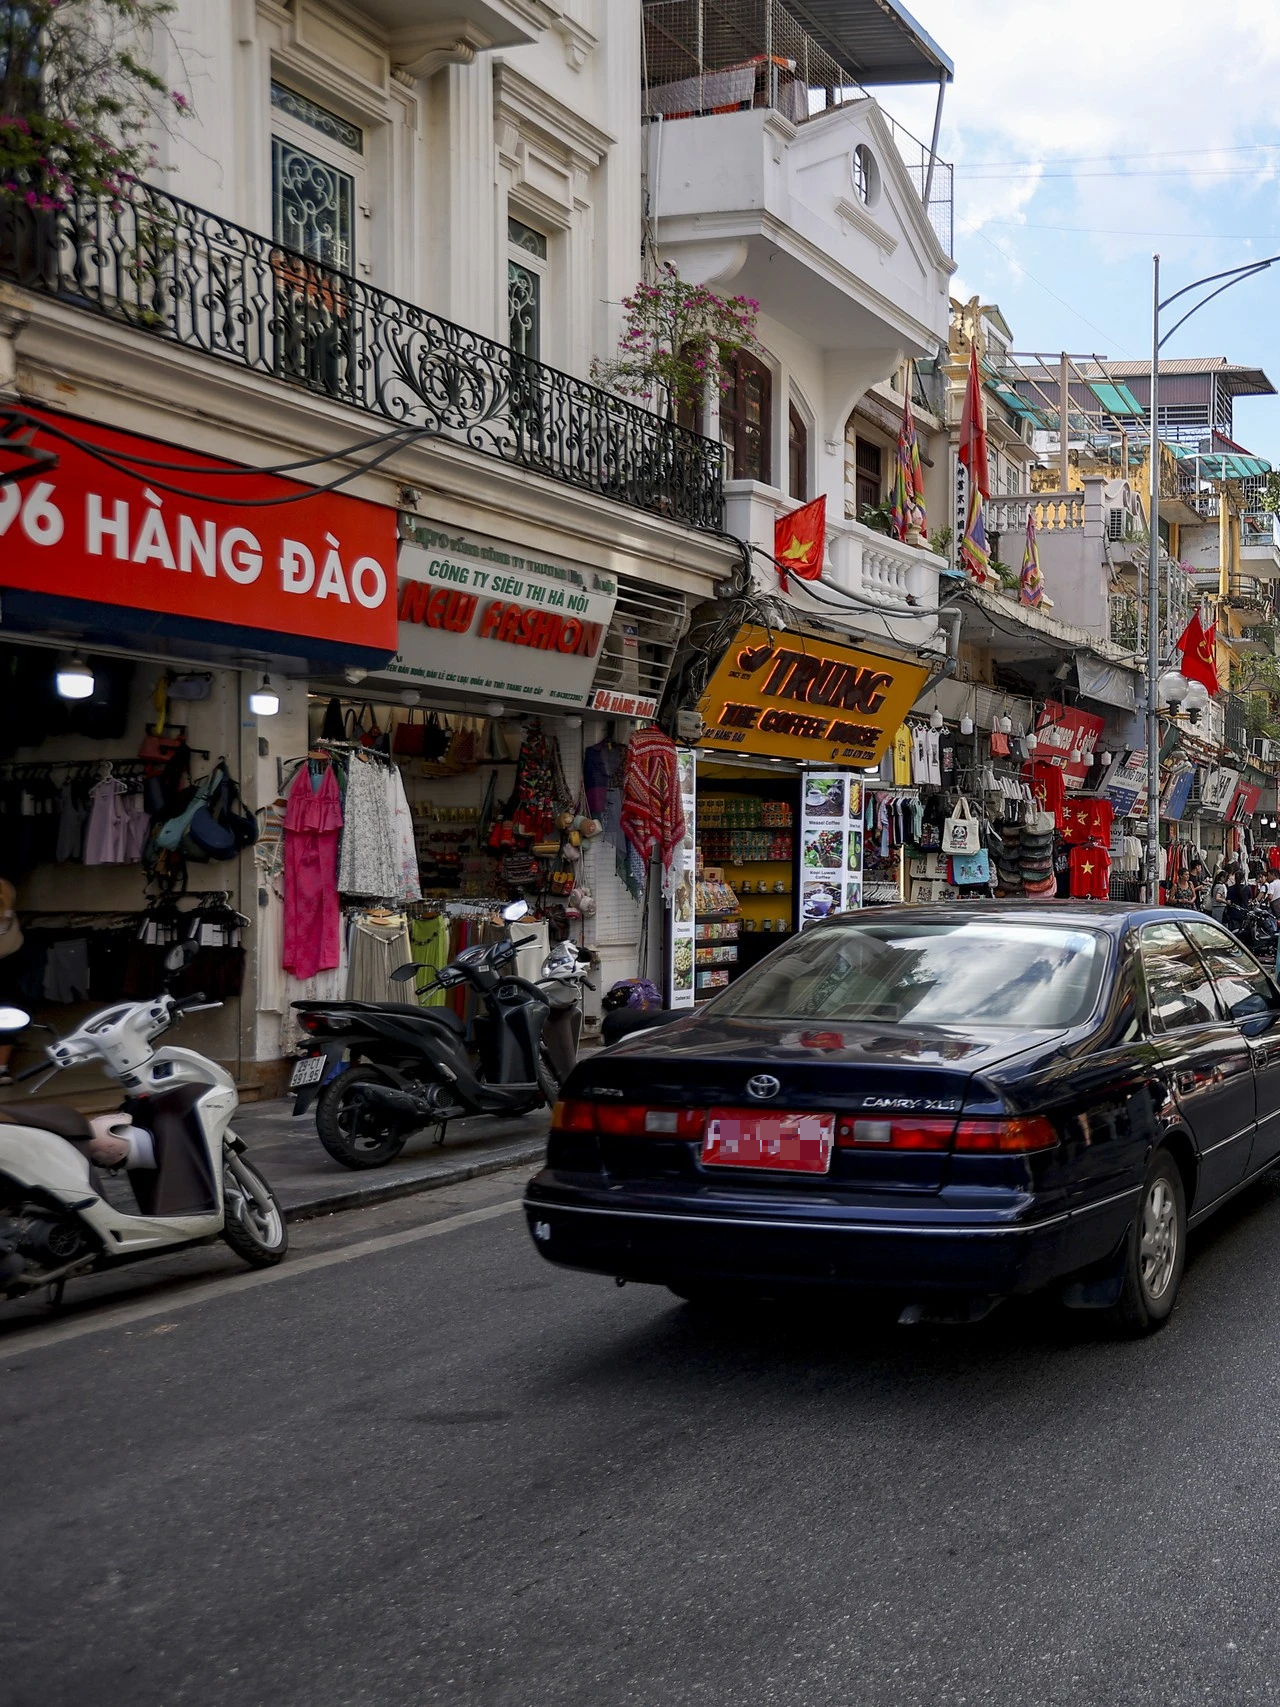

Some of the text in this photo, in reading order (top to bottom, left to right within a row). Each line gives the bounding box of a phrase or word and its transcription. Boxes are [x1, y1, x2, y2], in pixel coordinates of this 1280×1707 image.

[86, 487, 263, 585] HÀNG
[280, 531, 387, 609] ĐÀO
[428, 559, 589, 614] CÔNG TY SIÊU THỊ HÀ NỘI
[398, 580, 604, 658] NEW FASHION
[595, 691, 611, 711] 94
[611, 695, 635, 714] HÀNG
[761, 647, 894, 714] TRUNG
[717, 702, 884, 748] THE COFFEE HOUSE
[291, 1069, 320, 1086] 991.95
[862, 1097, 921, 1109] CAMRY
